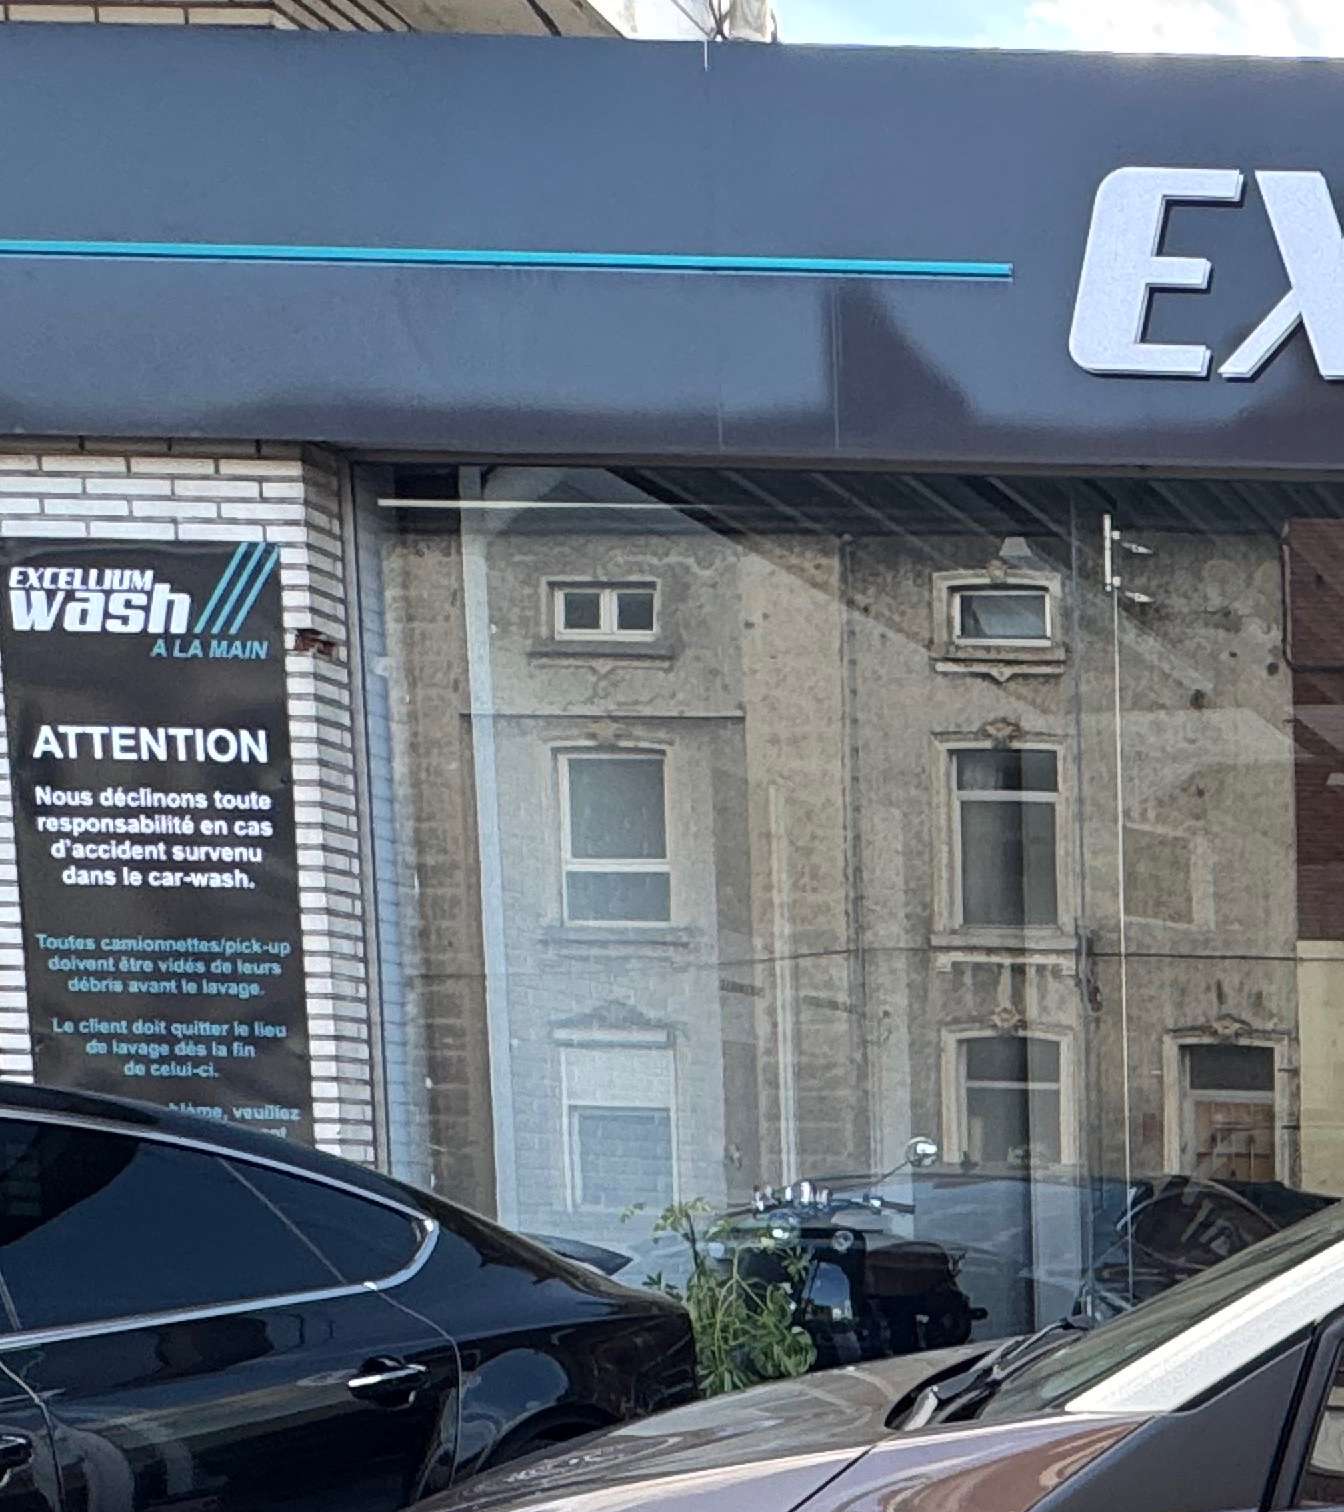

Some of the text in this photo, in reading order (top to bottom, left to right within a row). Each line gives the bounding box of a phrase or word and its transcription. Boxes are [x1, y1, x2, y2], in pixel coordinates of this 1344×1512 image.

[8, 566, 154, 592] EXCELLIUM
[9, 583, 192, 634] wash
[172, 639, 203, 658] LA
[210, 640, 269, 660] MAIN
[32, 724, 268, 764] ATTENTION
[35, 786, 272, 810] Nous déclinons toute
[36, 815, 274, 837] responsabilité en cas
[50, 840, 262, 862] d'accident survenu
[62, 866, 256, 889] dans le car-wash.
[36, 934, 290, 956] Toutes camionnettes/pick-up
[48, 955, 282, 976] doivent être vidés de leurs
[68, 977, 264, 1000] débris avant le lavage.
[52, 1018, 286, 1038] Le client doit quitter le lieu
[86, 1039, 256, 1059] de lavage dès la fin
[124, 1060, 219, 1078] de celui-ci.
